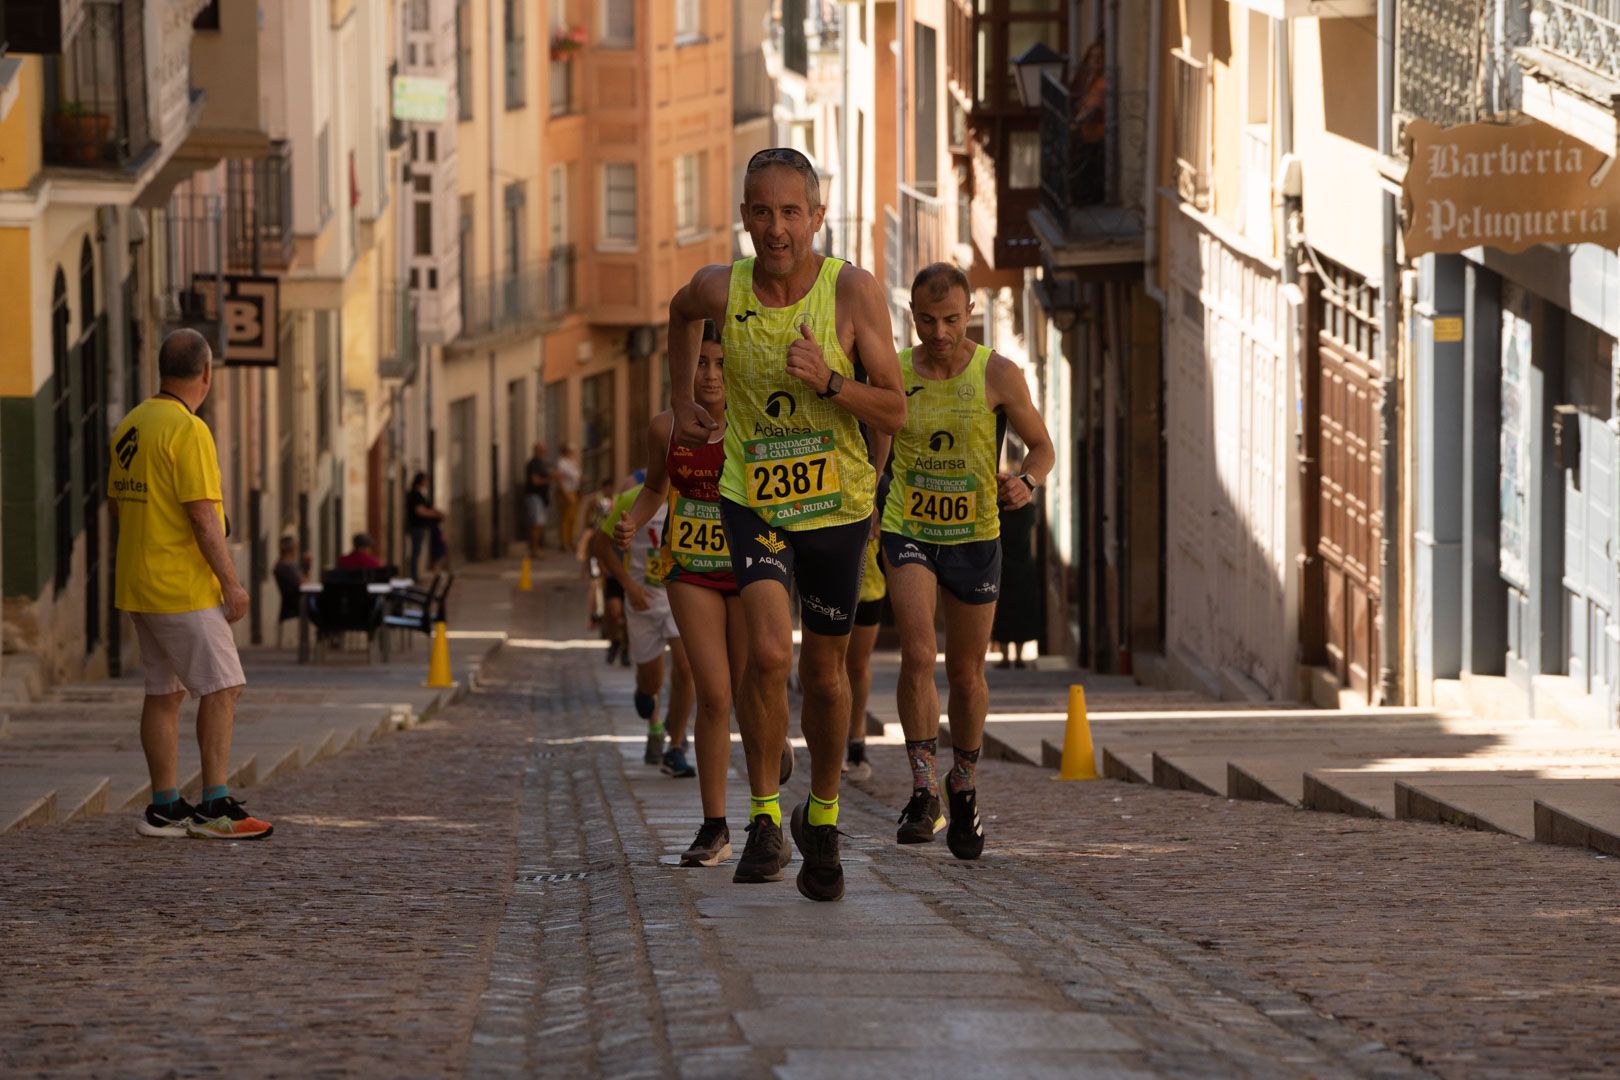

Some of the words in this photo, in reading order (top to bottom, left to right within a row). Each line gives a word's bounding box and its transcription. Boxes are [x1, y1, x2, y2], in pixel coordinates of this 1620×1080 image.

[754, 422, 811, 437] Adarsa
[770, 449, 791, 458] CAJA
[792, 445, 823, 456] RURAL
[915, 457, 966, 469] Adarsa
[754, 458, 827, 501] 2387
[802, 500, 837, 513] RURAL
[910, 492, 968, 521] 2406
[678, 521, 725, 552] 245
[924, 527, 942, 536] CAJA
[944, 527, 971, 536] RURAL
[692, 559, 713, 568] CAJA
[715, 560, 733, 568] RUR
